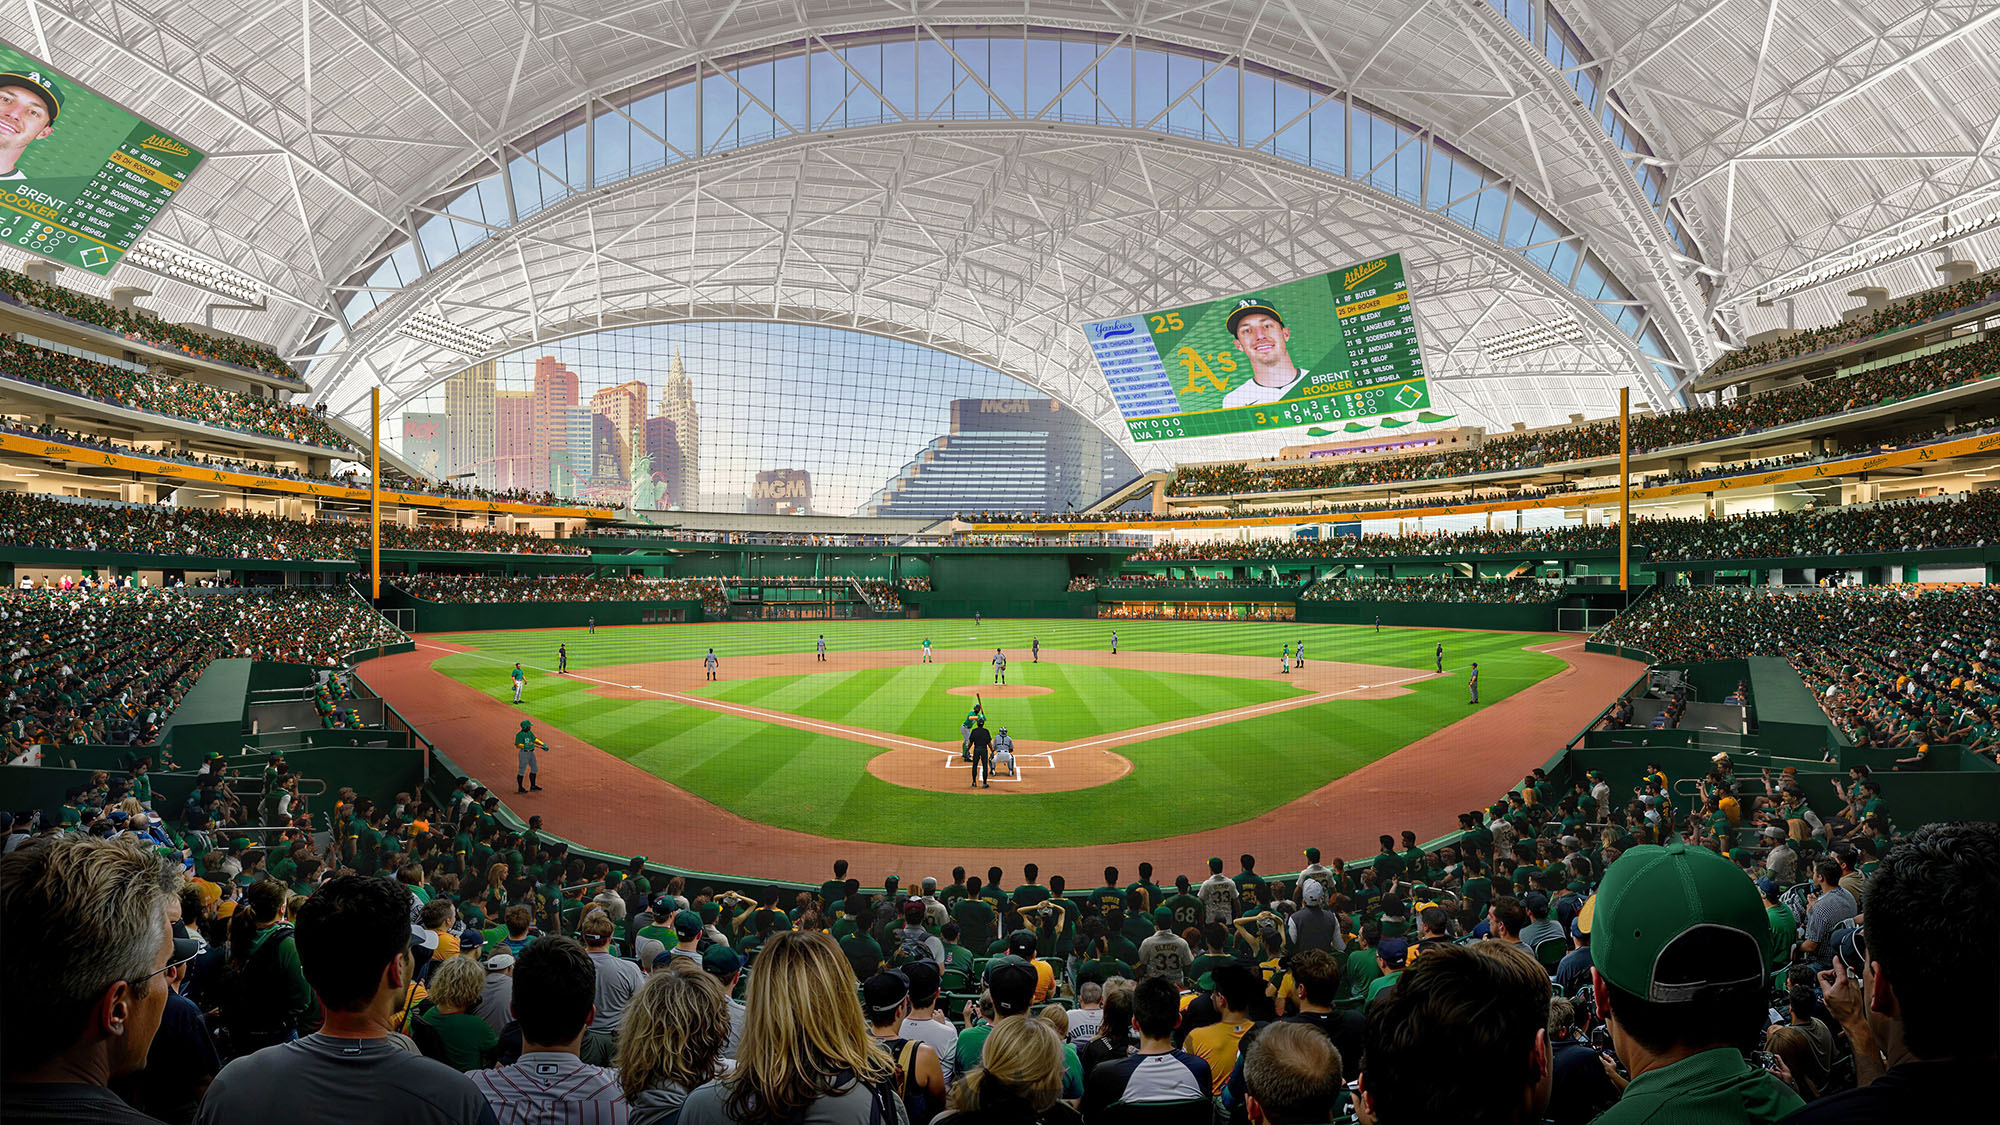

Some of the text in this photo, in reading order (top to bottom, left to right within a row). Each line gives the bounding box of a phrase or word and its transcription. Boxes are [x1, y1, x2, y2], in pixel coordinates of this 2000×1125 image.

[140, 134, 191, 156] Athletics
[130, 148, 139, 156] RF
[140, 154, 162, 168] BUTLER
[105, 162, 115, 170] 33
[124, 170, 148, 184] BLEDAY
[122, 157, 132, 166] DH
[133, 162, 156, 177] ROOKER
[98, 170, 108, 179] 23
[118, 180, 150, 198] LANGELIERS
[16, 184, 67, 210] BRENT
[82, 189, 92, 197] 22
[102, 198, 130, 214] ANDUJAR
[110, 189, 146, 209] SODERSTROM
[74, 198, 84, 206] 20
[95, 208, 116, 218] GELOF
[13, 216, 22, 225] 1
[32, 221, 41, 230] B
[88, 216, 112, 229] WILSON
[25, 229, 35, 237] S
[80, 224, 107, 240] URSHELA
[1344, 259, 1387, 290] Athletics
[1344, 294, 1352, 302] RF
[1355, 288, 1376, 300] BUTLER
[1358, 300, 1381, 310] ROOKER
[1150, 312, 1184, 334] 25
[1360, 312, 1381, 322] BLEDAY
[1092, 320, 1134, 340] Yankees
[1362, 320, 1396, 332] LANGELIERS
[1365, 330, 1402, 343] SODERSTROM
[1368, 342, 1394, 353] ANDUJAR
[1370, 354, 1388, 363] GELOF
[1177, 346, 1237, 396] A's
[1372, 364, 1394, 373] WILSON
[1311, 370, 1350, 384] BRENT
[1375, 374, 1400, 384] URSHELA
[1302, 380, 1353, 396] ROOKER
[1330, 398, 1336, 407] 1
[1344, 394, 1352, 402] B
[980, 399, 1030, 414] MGM
[1290, 403, 1299, 412] 0
[1310, 400, 1318, 410] 3
[1323, 405, 1331, 414] E
[1255, 412, 1267, 424] 3
[1284, 410, 1292, 419] R
[1304, 408, 1312, 416] H
[1312, 412, 1324, 422] 10
[1333, 410, 1342, 418] 0
[1129, 418, 1180, 430] NYY 0 0 0
[1294, 414, 1302, 424] 9
[1134, 428, 1184, 441] LVA 7 0 2
[1918, 448, 1934, 460] A's
[751, 479, 806, 500] MGM
[1174, 906, 1196, 923] 68
[1155, 953, 1180, 971] 33
